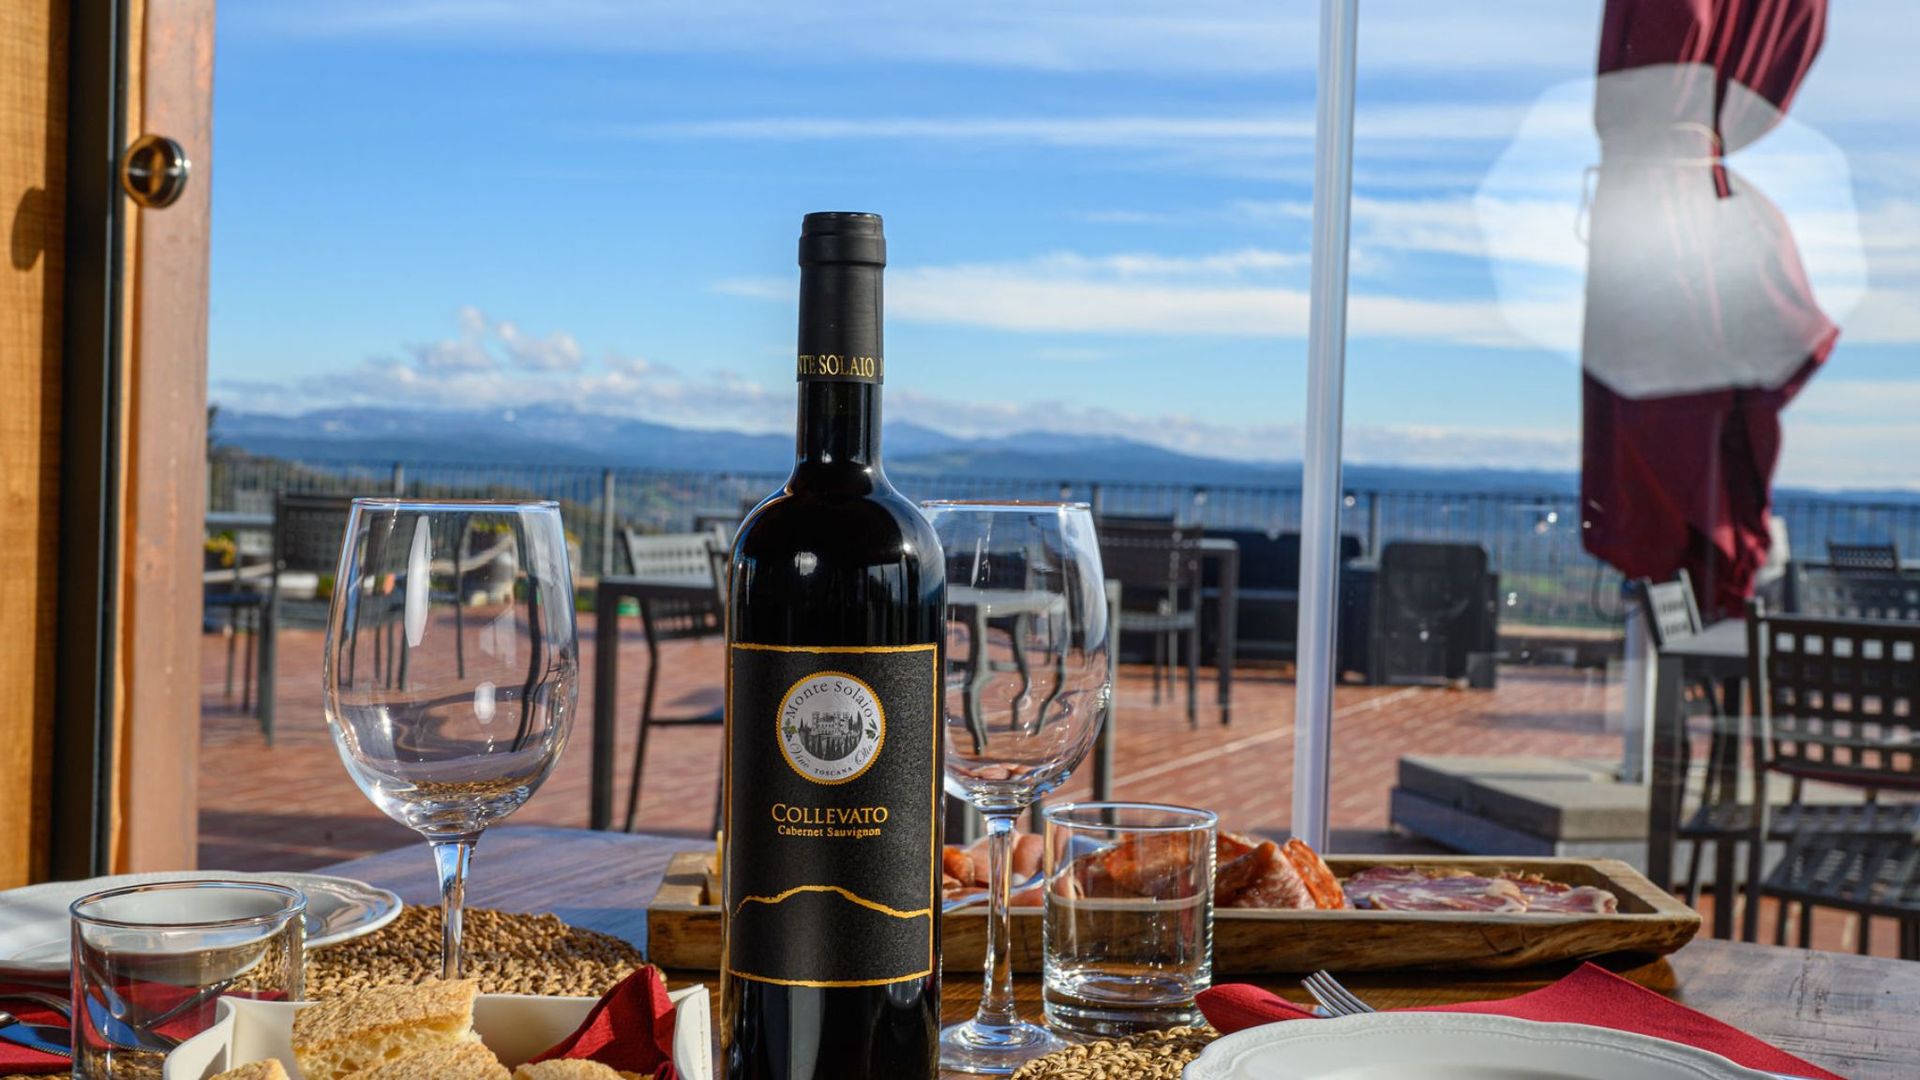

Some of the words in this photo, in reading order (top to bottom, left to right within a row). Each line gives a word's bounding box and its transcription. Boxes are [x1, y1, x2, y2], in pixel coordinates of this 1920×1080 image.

[818, 354, 875, 378] SOLAIO
[786, 681, 828, 719] Monte
[833, 681, 873, 718] Solaio
[814, 766, 853, 777] TOSCANA
[771, 803, 889, 824] COLLEVATO
[777, 825, 823, 837] Cabernet
[827, 827, 881, 839] Sauvignon
